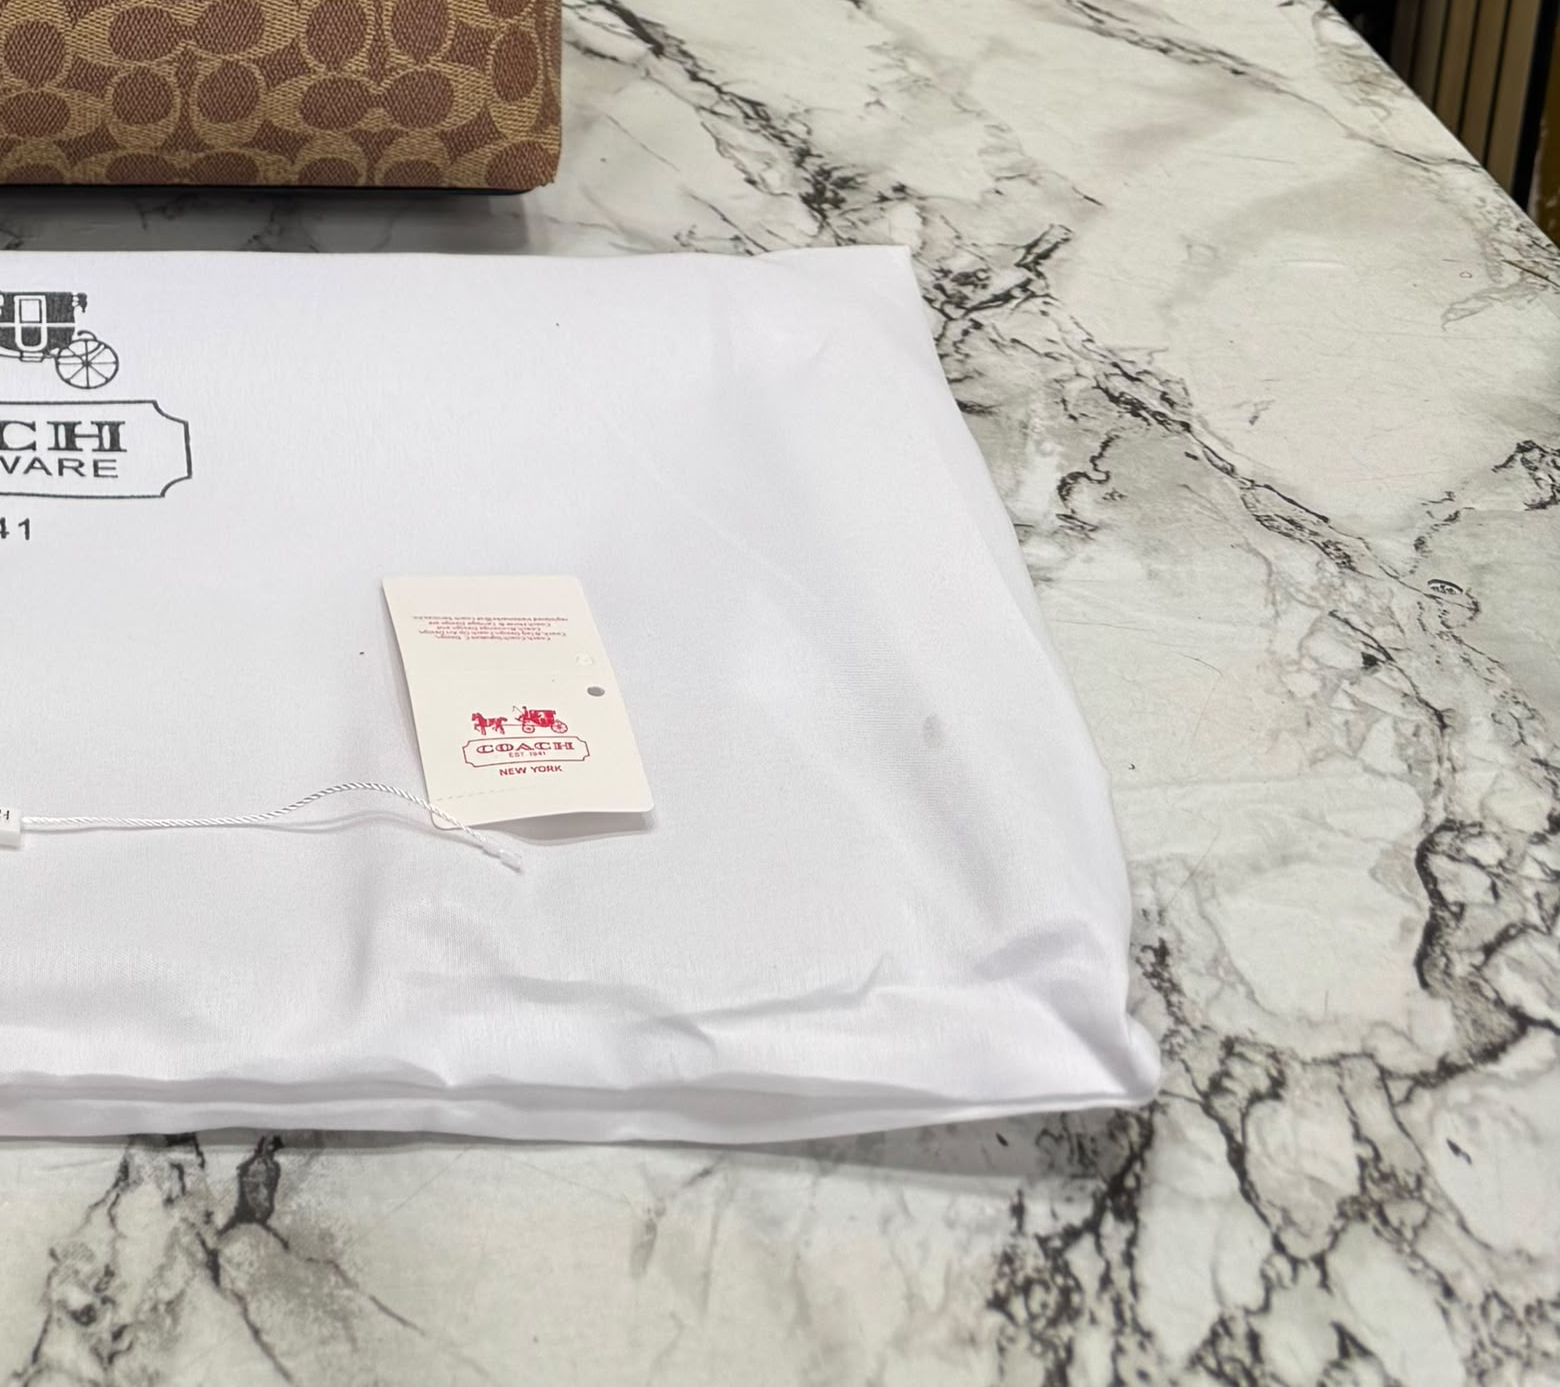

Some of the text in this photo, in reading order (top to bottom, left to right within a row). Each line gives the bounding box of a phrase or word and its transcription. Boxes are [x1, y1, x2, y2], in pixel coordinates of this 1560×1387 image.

[476, 741, 575, 754] COACH
[499, 765, 563, 776] NEW YORK
